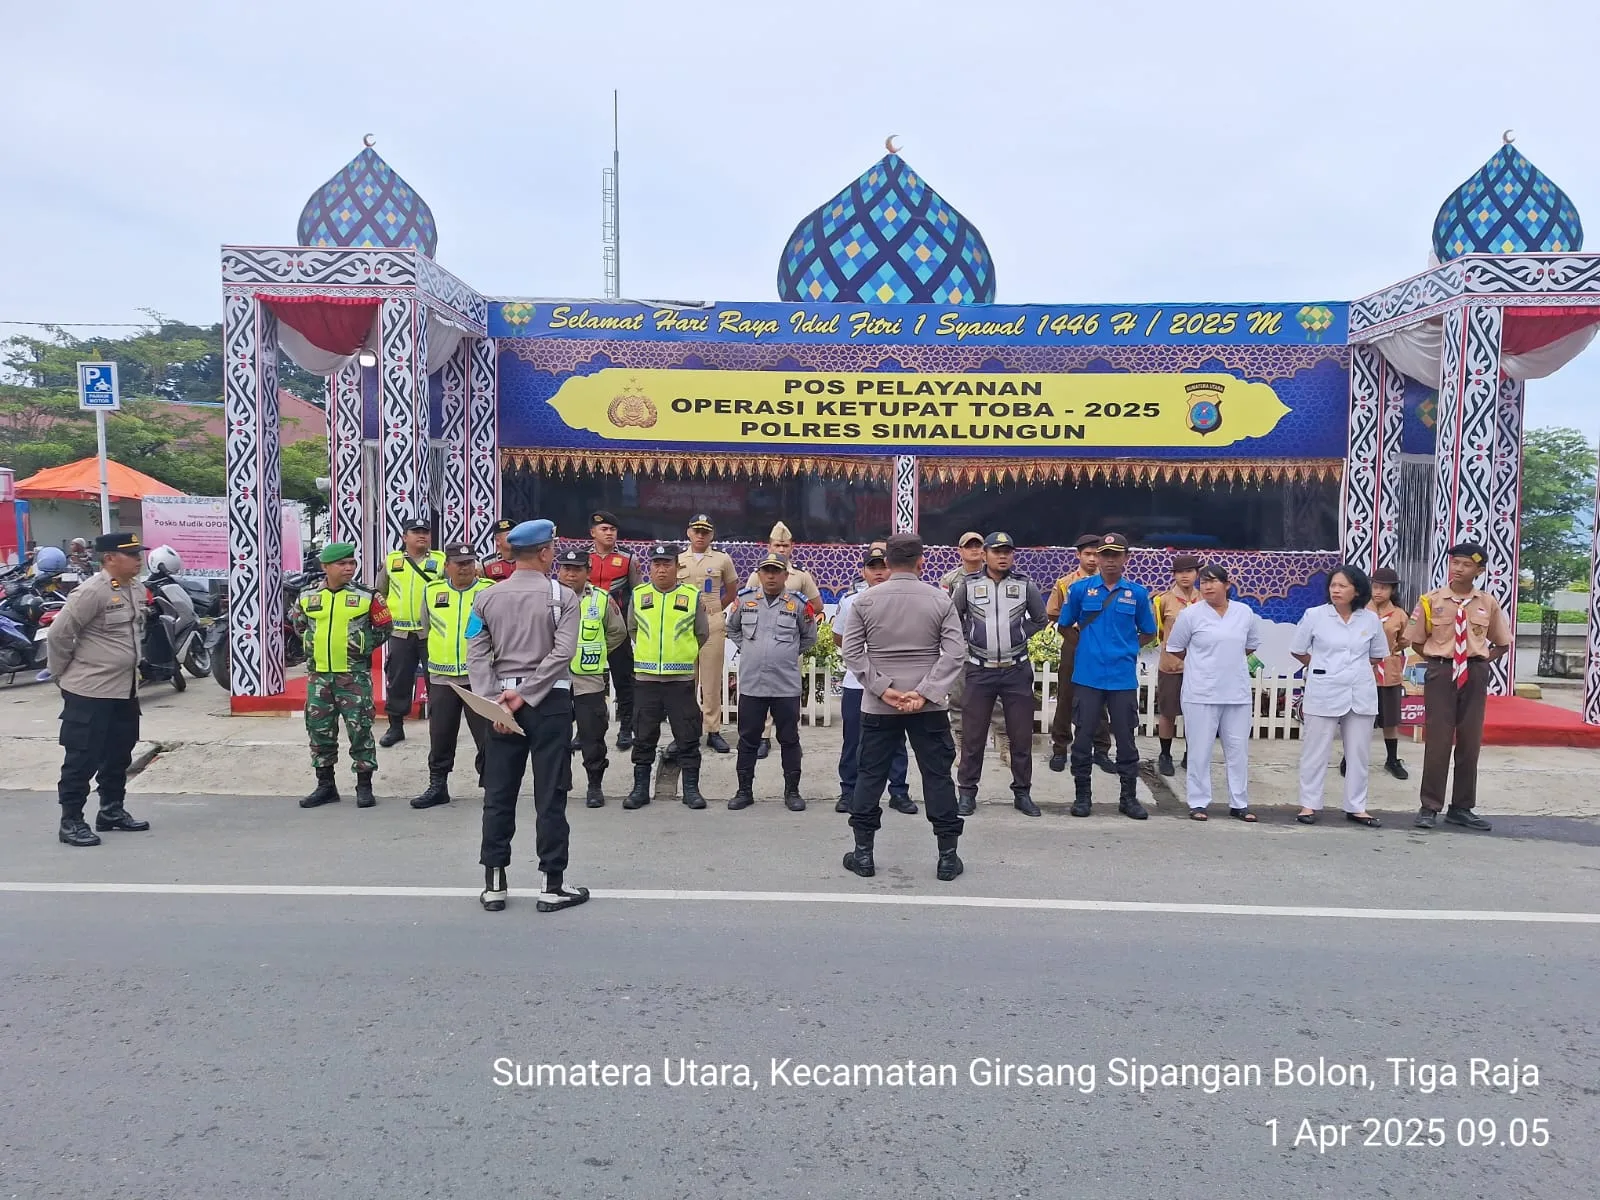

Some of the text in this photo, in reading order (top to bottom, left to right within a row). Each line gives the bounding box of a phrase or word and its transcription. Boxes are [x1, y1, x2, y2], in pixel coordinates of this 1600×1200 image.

[548, 305, 1283, 342] Selamat Hari Raya Idul Fitri 1 Syawal 1446 H / 2025 M
[85, 368, 100, 385] P
[783, 379, 1043, 396] POS PELAYANAN
[670, 398, 804, 415] OPERASI
[816, 401, 959, 417] KETUPAT
[968, 402, 1055, 418] TOBA
[1084, 402, 1161, 419] 2025
[740, 421, 1086, 440] POLRES SIMALUNGUN
[154, 519, 178, 527] Posko
[179, 520, 204, 528] Mudik
